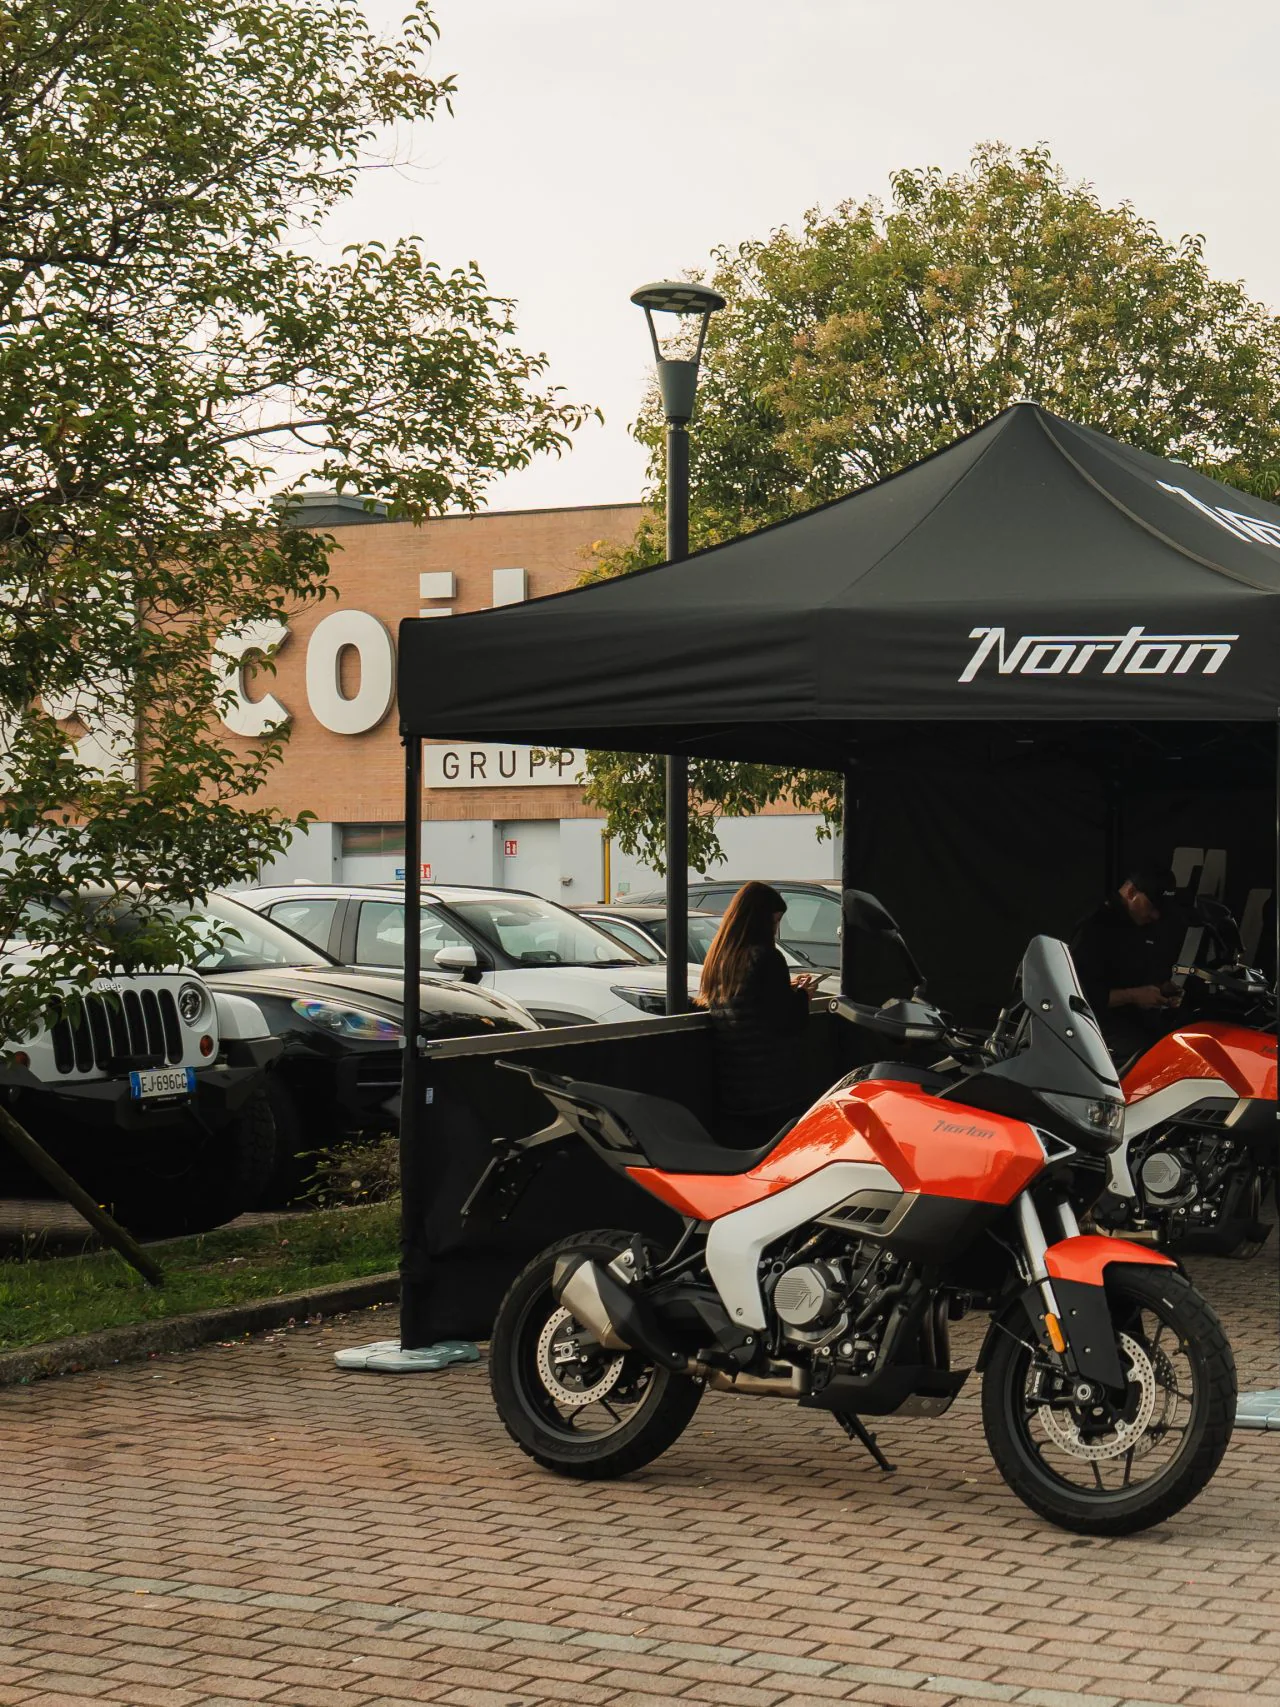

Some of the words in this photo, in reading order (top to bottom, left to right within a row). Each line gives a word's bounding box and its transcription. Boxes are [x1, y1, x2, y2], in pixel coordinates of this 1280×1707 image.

[957, 626, 1239, 682] Norton
[442, 750, 575, 780] GRUPP
[98, 981, 123, 993] Jeep
